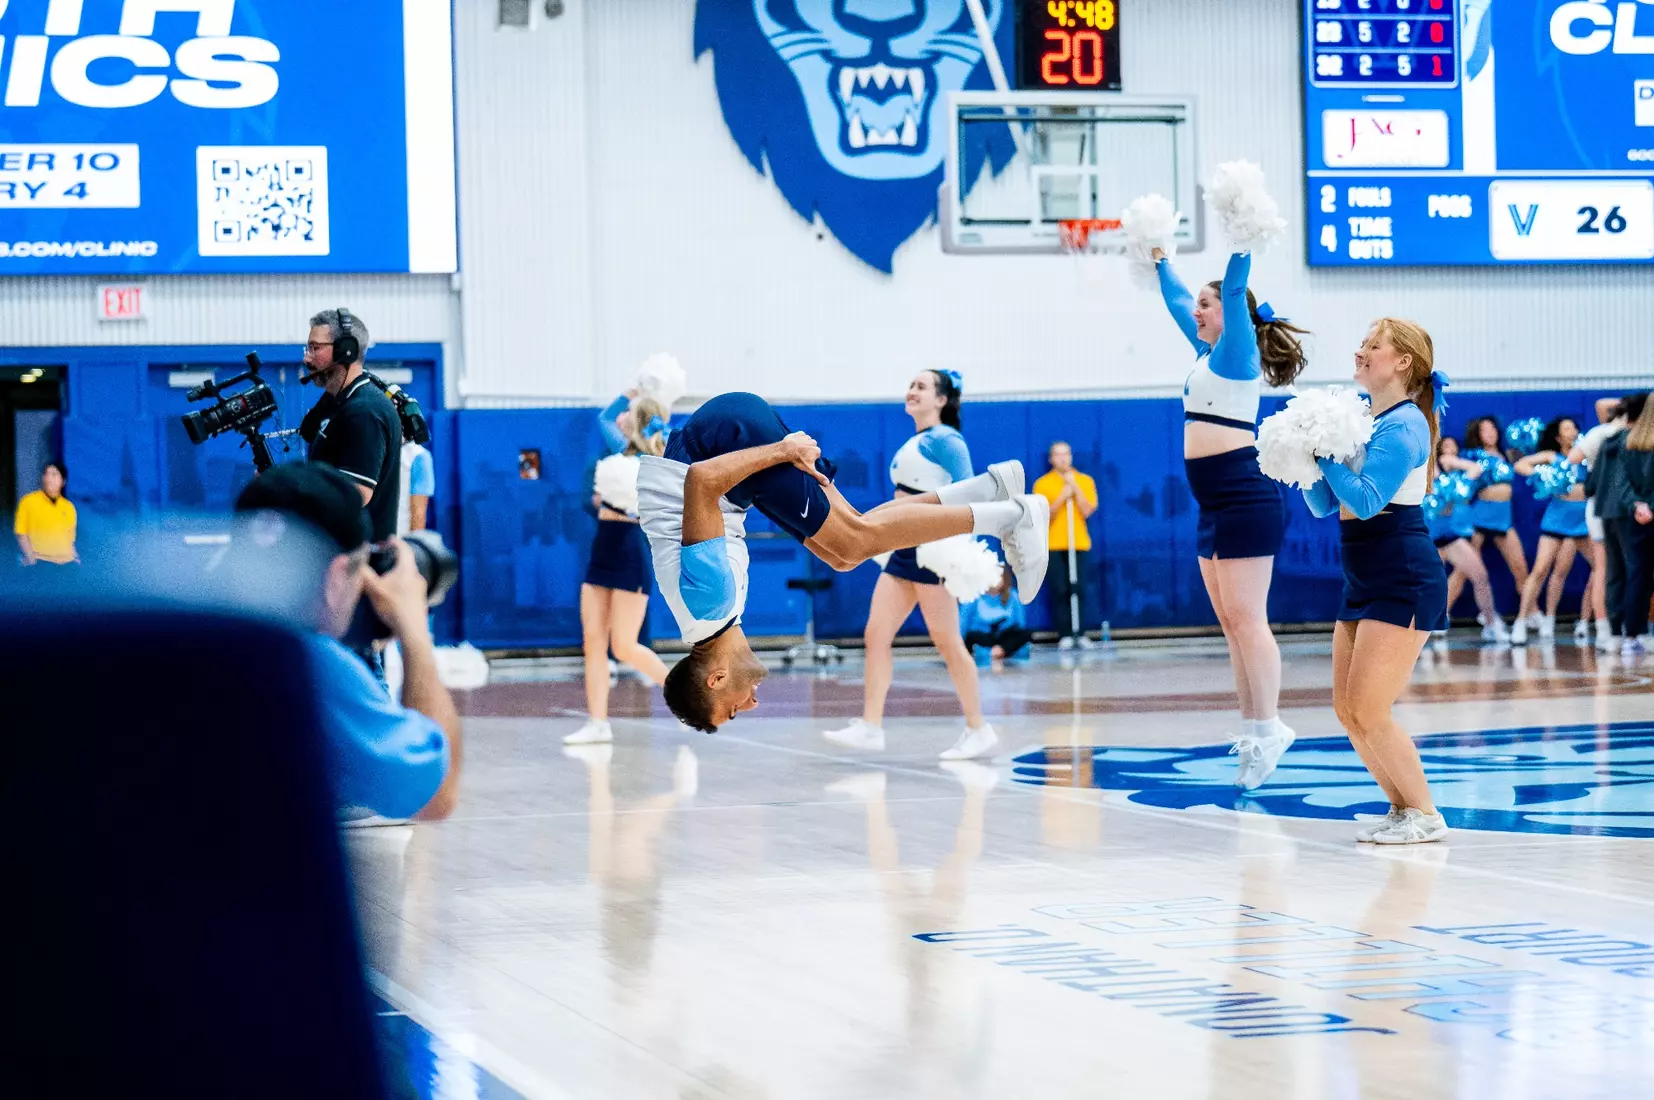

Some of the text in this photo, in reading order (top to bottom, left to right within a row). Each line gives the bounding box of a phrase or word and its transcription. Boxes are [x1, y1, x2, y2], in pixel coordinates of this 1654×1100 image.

[1047, 0, 1115, 30] 4:48
[1358, 21, 1372, 42] 5
[1397, 21, 1410, 42] 2
[0, 34, 280, 108] ICS
[1041, 30, 1103, 84] 20
[1359, 54, 1372, 76] 2
[1397, 54, 1411, 76] 5
[1431, 55, 1442, 76] 1
[74, 152, 120, 171] 10
[63, 181, 89, 199] 4
[1320, 184, 1336, 213] 2
[1576, 206, 1628, 234] 26
[104, 286, 141, 318] EXIT
